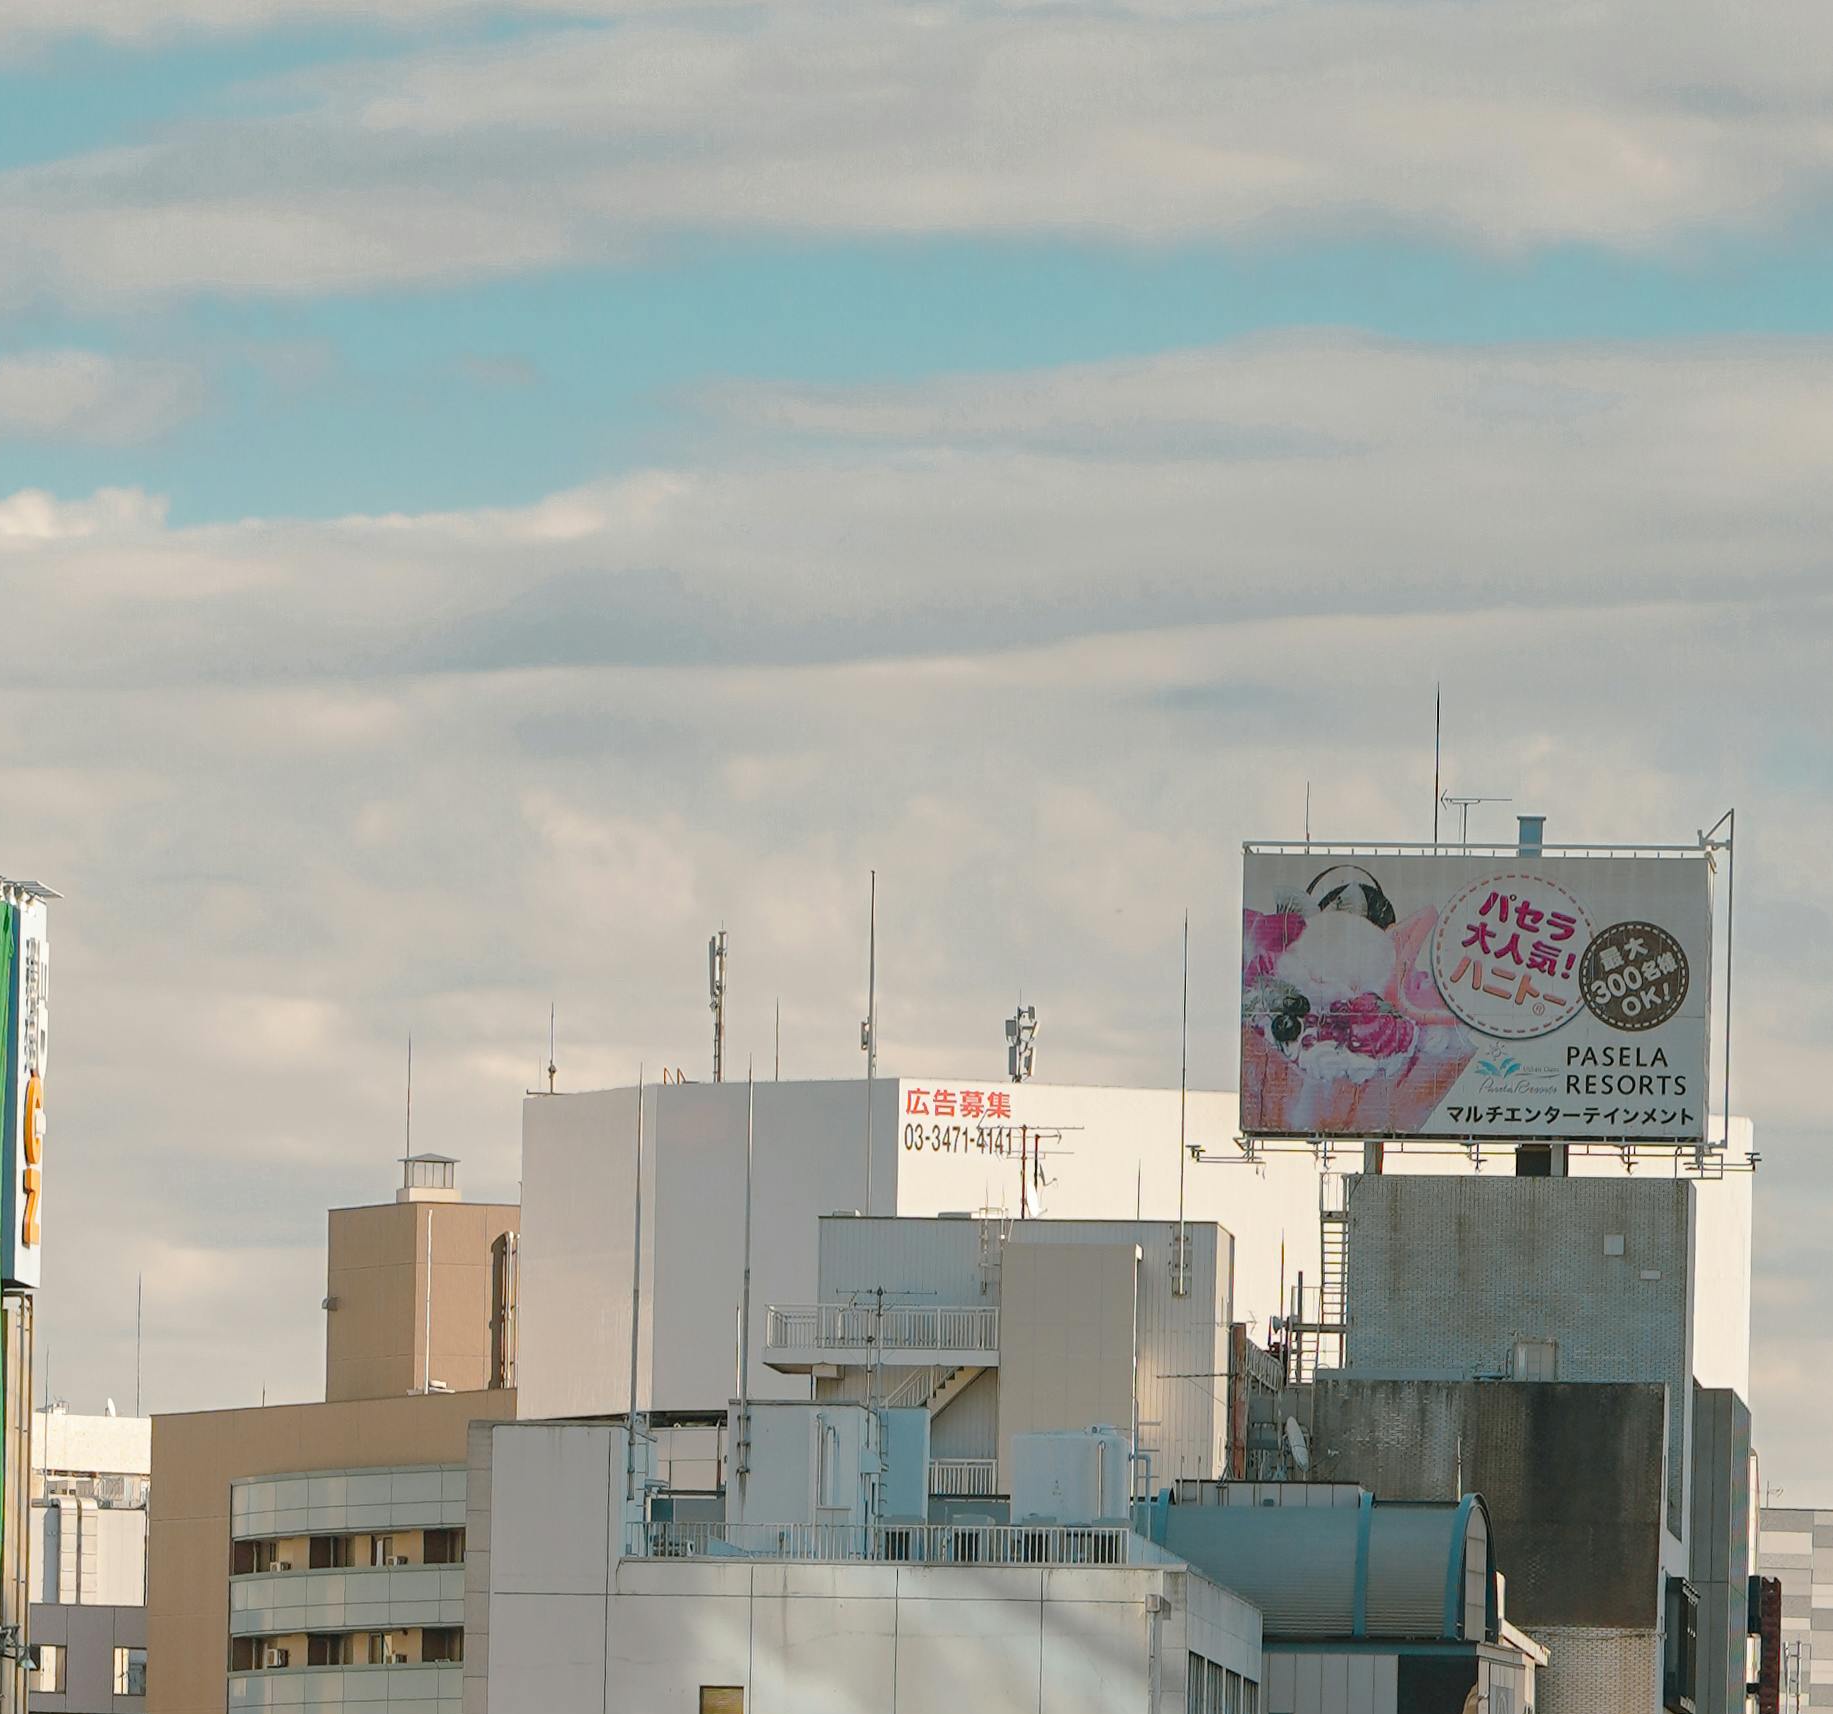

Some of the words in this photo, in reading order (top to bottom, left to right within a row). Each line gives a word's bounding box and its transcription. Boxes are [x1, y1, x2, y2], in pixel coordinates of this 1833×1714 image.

[1478, 892, 1577, 941] パセラ
[1599, 937, 1648, 971] 最大
[1449, 956, 1567, 1005] ハニトー
[1590, 952, 1678, 1004] 300名様
[1621, 982, 1672, 1016] OK!
[1566, 1046, 1669, 1068] PASELA
[1566, 1075, 1687, 1096] RESORTS
[906, 1088, 1011, 1119] 広告募集
[1446, 1105, 1694, 1126] マルチエンターテインメント
[904, 1123, 1012, 1155] 03-3471-4141
